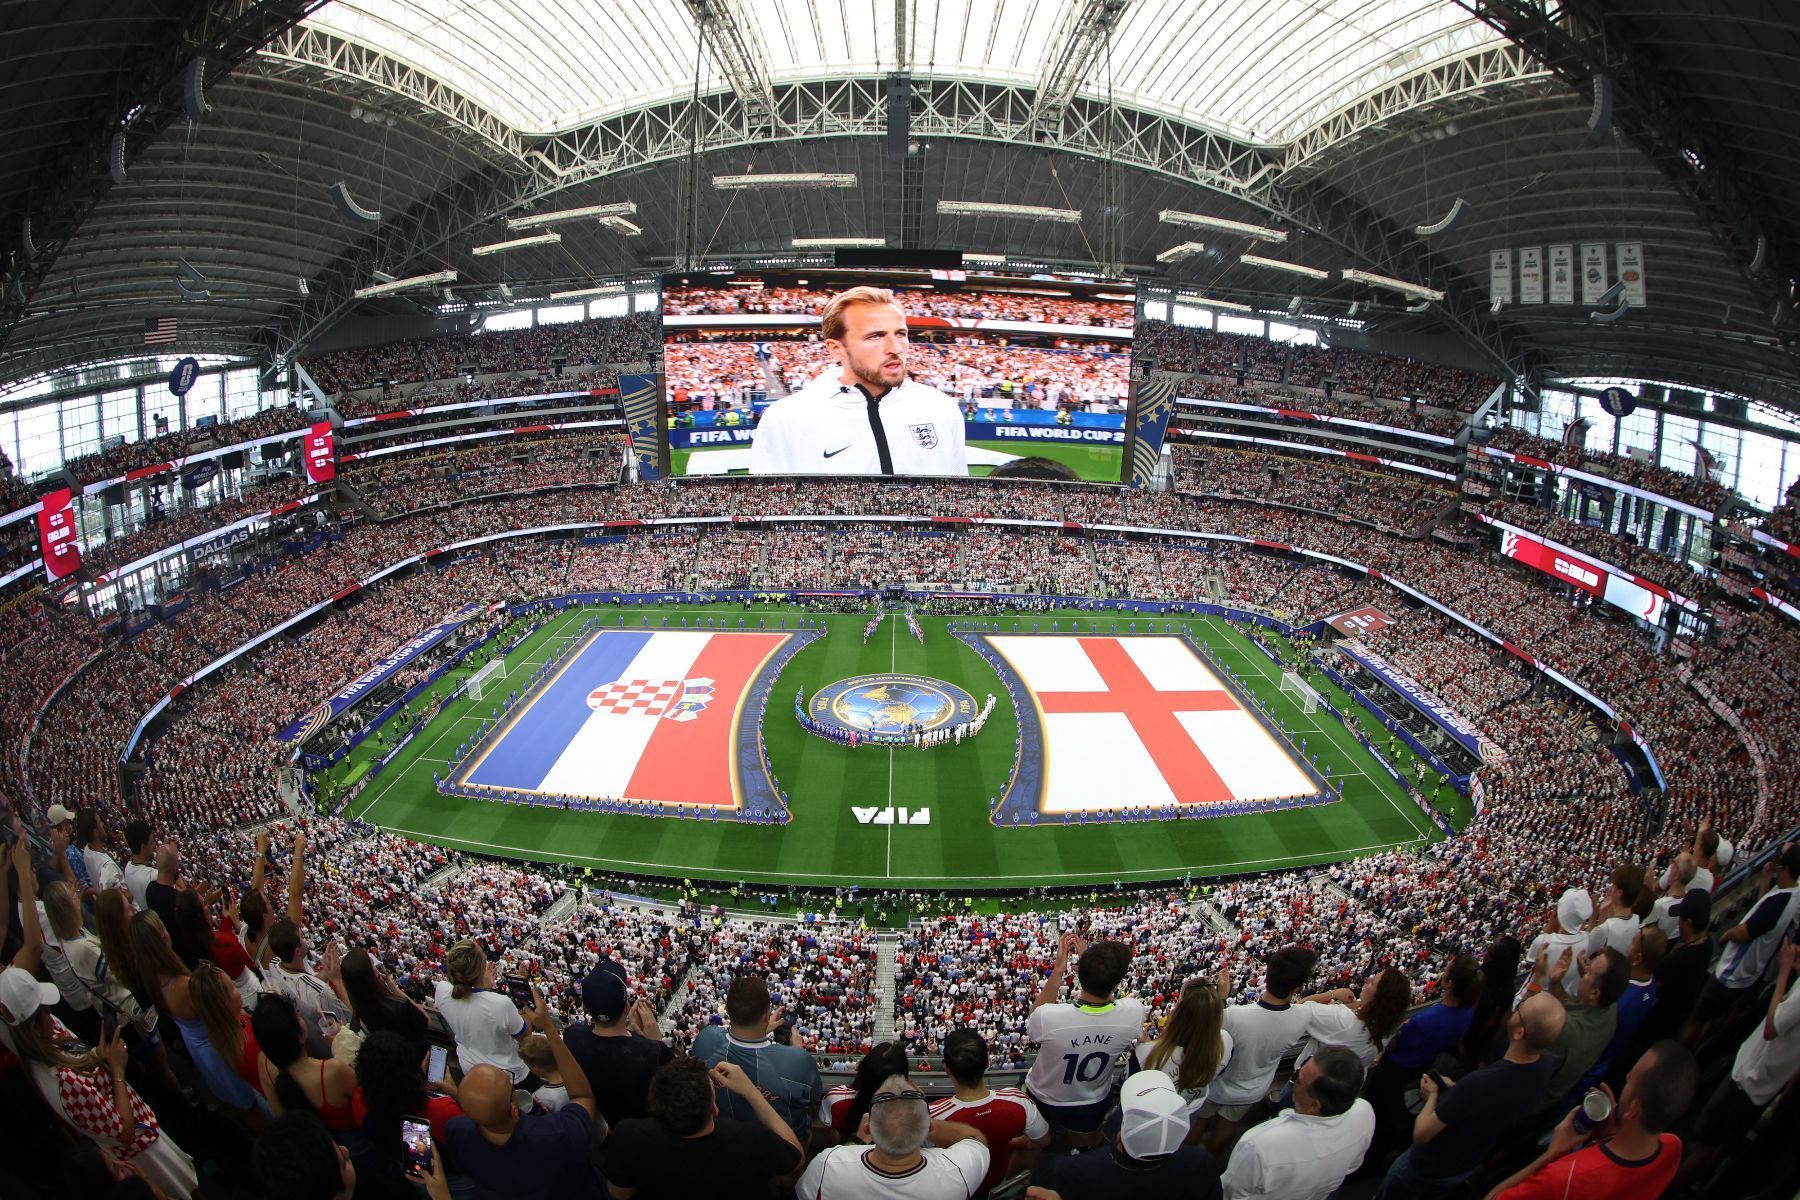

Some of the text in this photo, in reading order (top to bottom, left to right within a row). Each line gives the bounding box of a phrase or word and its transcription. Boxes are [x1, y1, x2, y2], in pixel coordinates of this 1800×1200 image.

[690, 431, 732, 443] FIFA
[995, 427, 1028, 437] FIFA
[1029, 428, 1082, 439] WORLD
[1083, 430, 1113, 441] CUP
[193, 530, 249, 560] DALLAS
[338, 629, 442, 699] FIFA WORLD CUP 2026
[1381, 669, 1417, 693] WORLD
[1413, 692, 1436, 707] CUP
[851, 806, 930, 825] FIFA
[1071, 1034, 1114, 1050] KANE
[1062, 1051, 1110, 1085] 10
